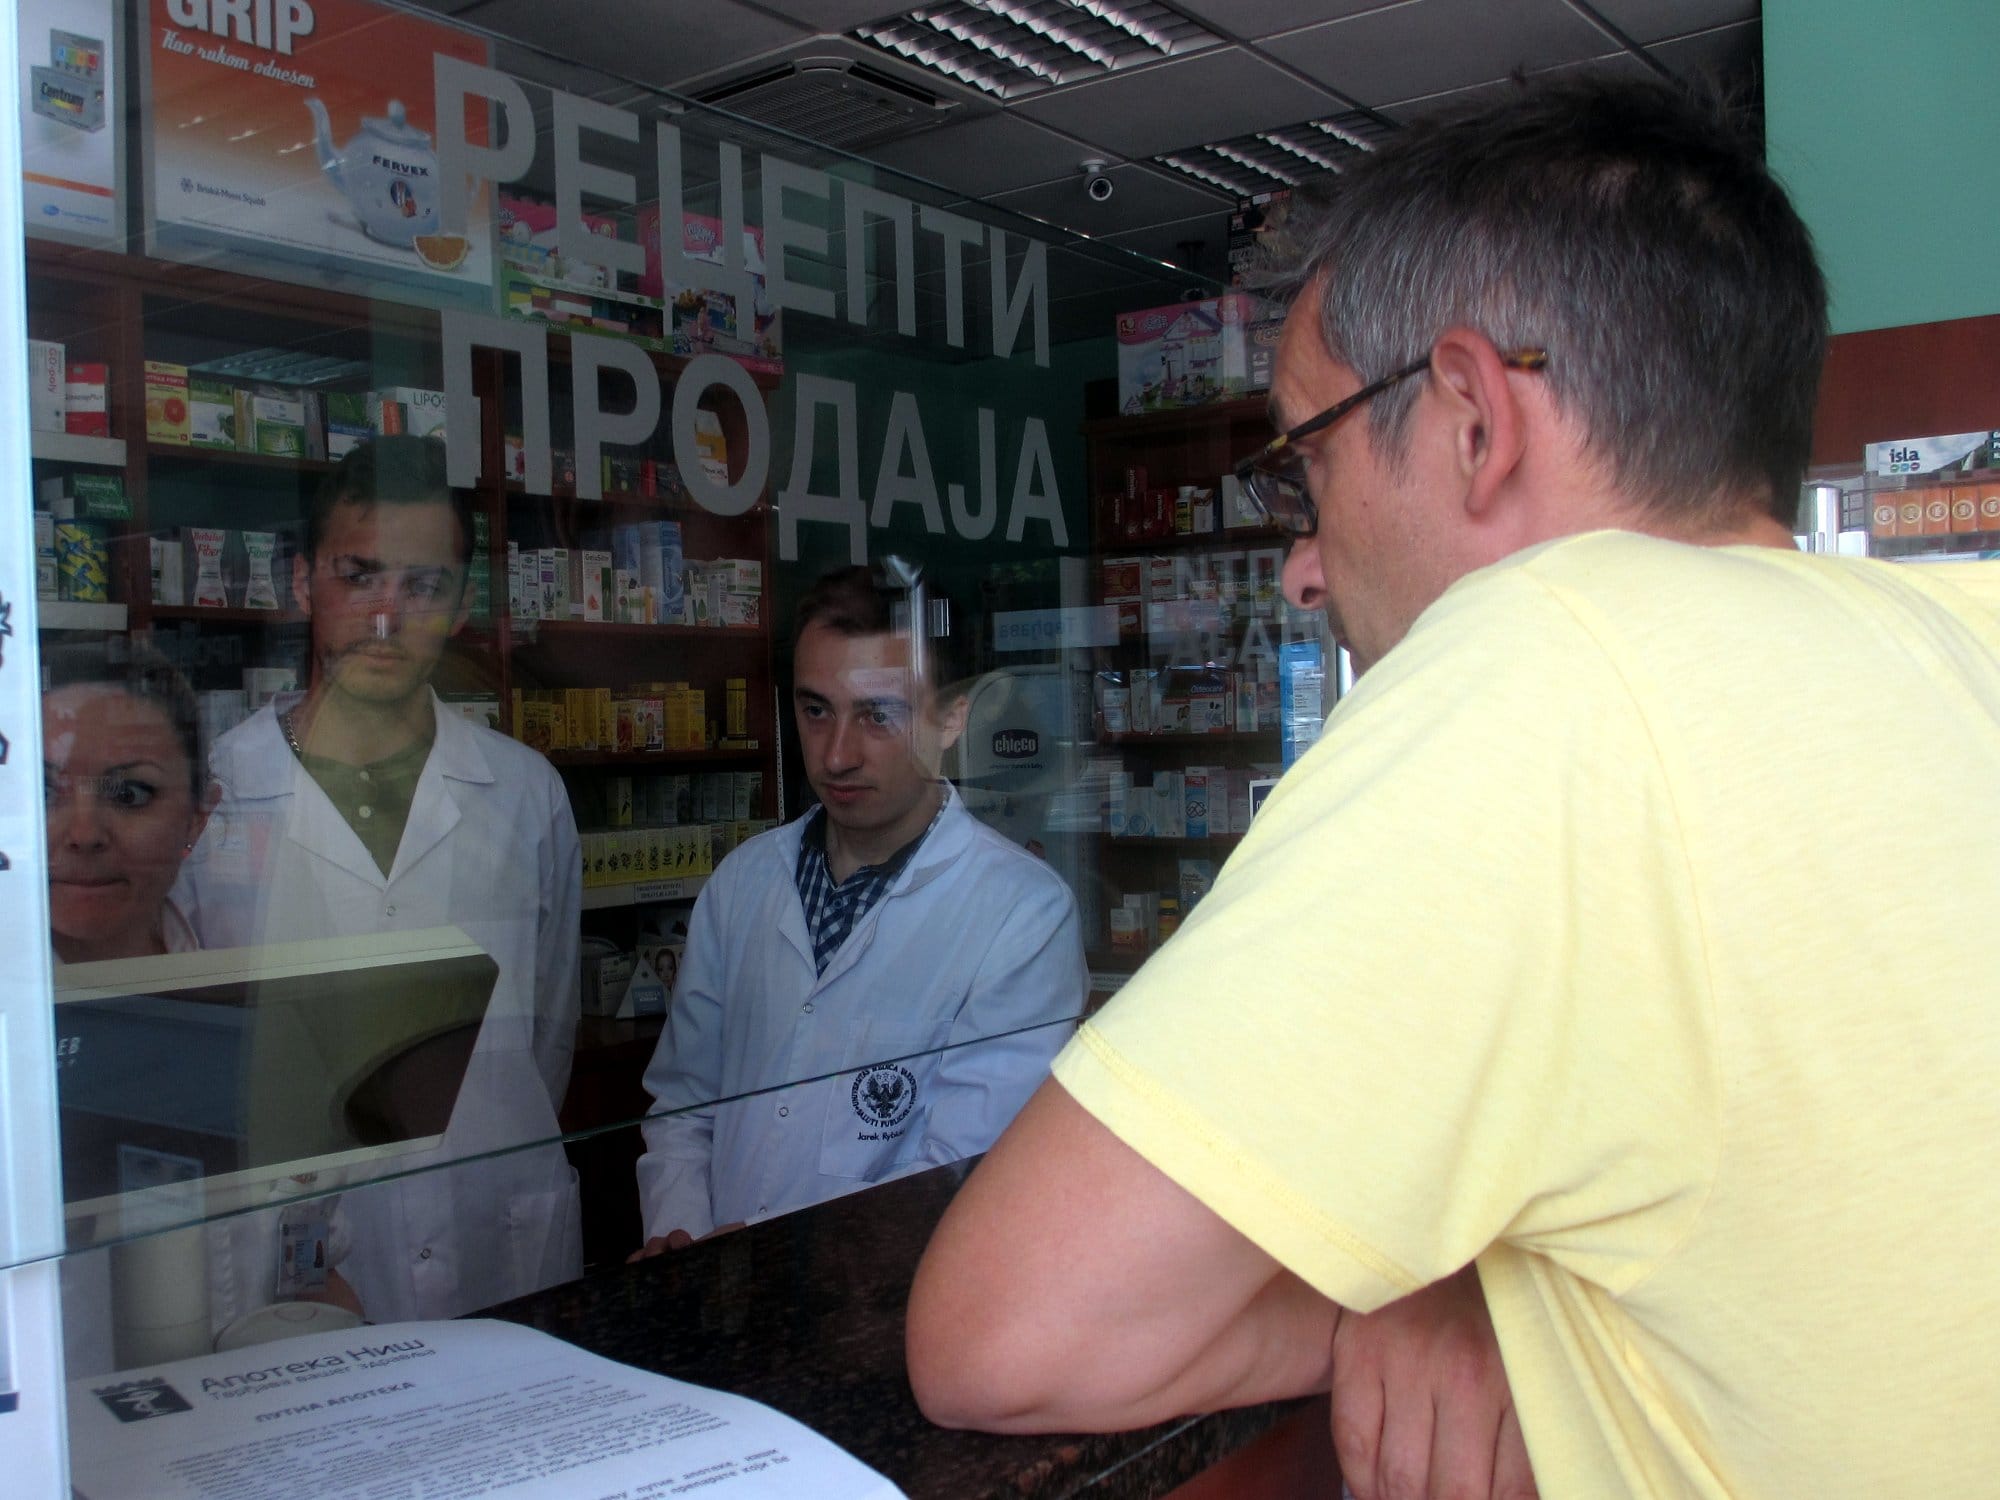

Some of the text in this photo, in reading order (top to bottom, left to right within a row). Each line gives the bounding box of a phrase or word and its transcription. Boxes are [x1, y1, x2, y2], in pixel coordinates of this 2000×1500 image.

[167, 0, 315, 56] GRIP
[161, 28, 315, 88] Kao rukom odnesen
[372, 155, 429, 177] FERVEX
[434, 52, 1050, 368] РЕЦЕПТИ
[441, 312, 1068, 565] ПРОДАЈА
[1889, 447, 1920, 463] isla
[995, 734, 1036, 753] chicco
[857, 1131, 879, 1141] Jarek
[201, 1340, 425, 1392] Апотека Ниш
[327, 1382, 415, 1407] АПОТЕКА
